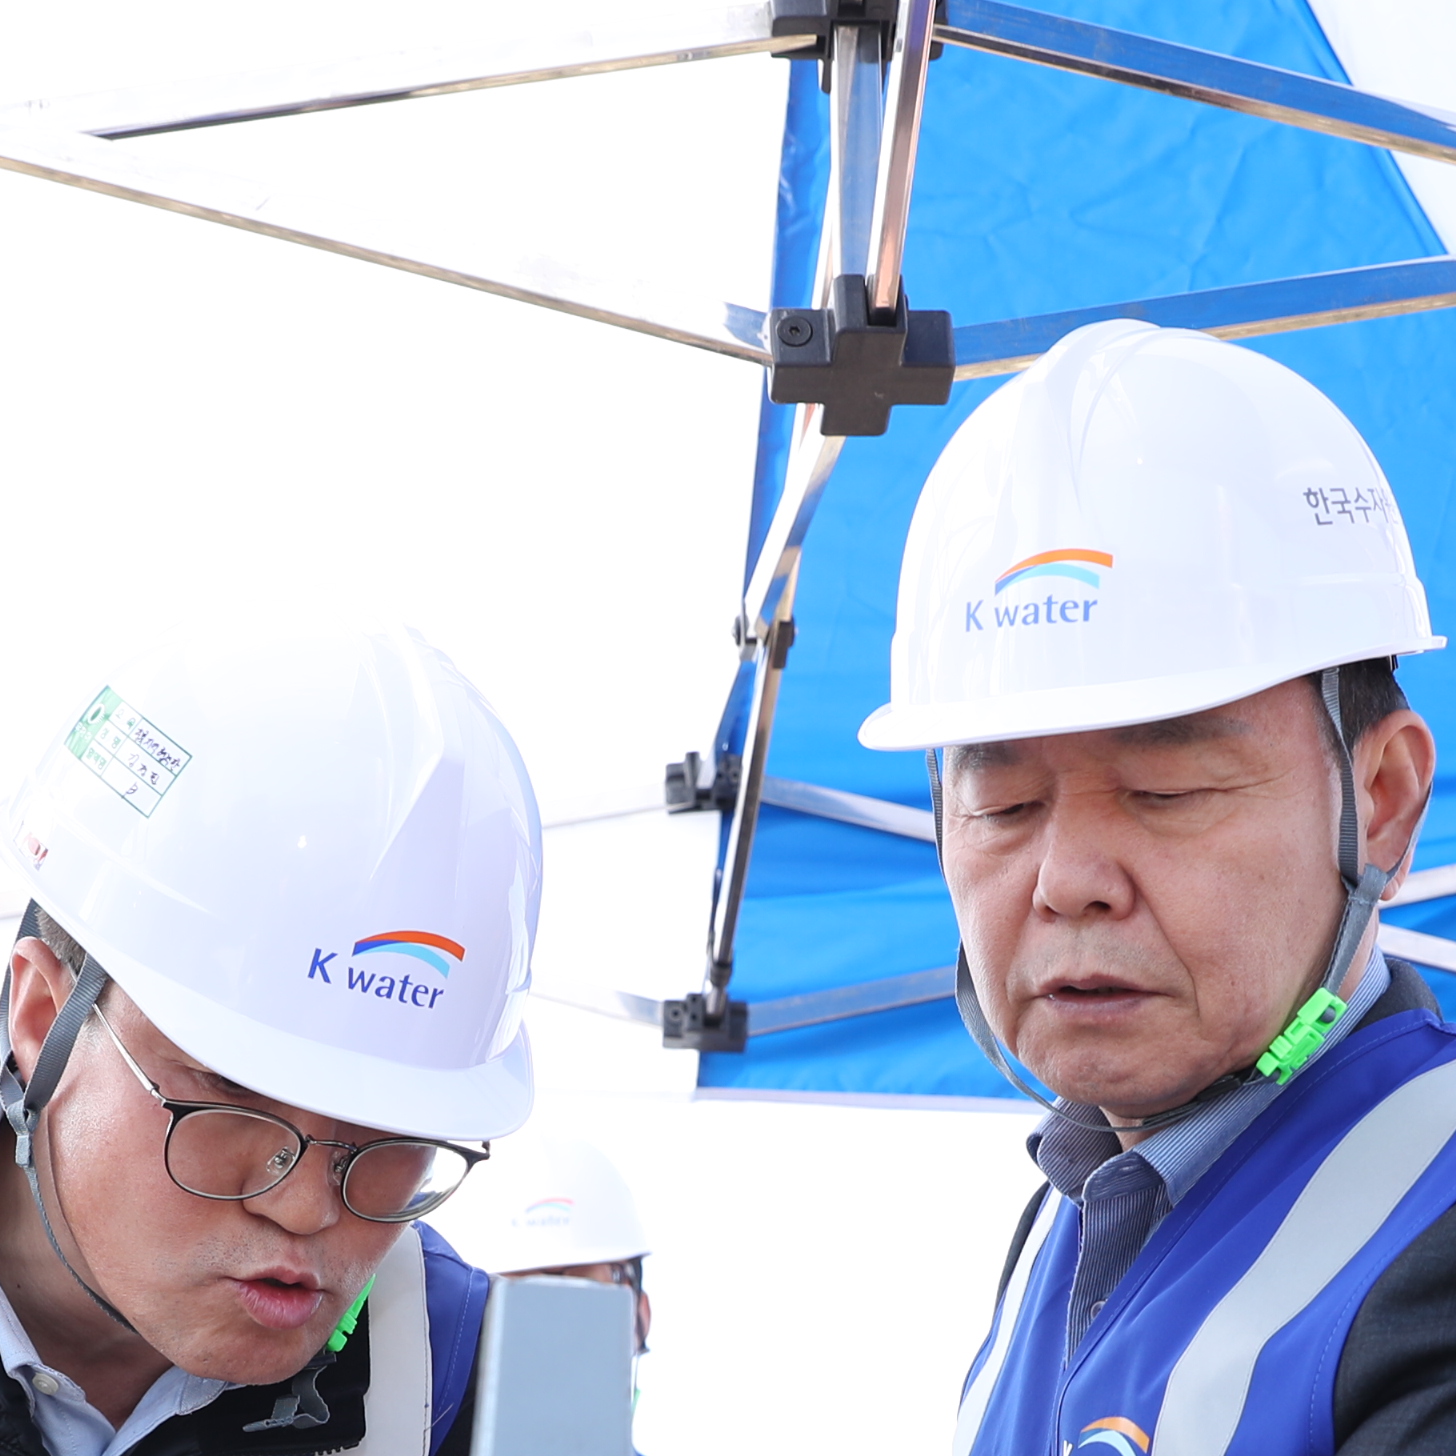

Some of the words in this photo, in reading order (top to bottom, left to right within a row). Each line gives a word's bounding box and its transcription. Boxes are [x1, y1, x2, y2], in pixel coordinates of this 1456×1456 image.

[965, 600, 984, 632] K
[994, 594, 1099, 629] water
[306, 948, 338, 984] K
[347, 967, 444, 1009] water
